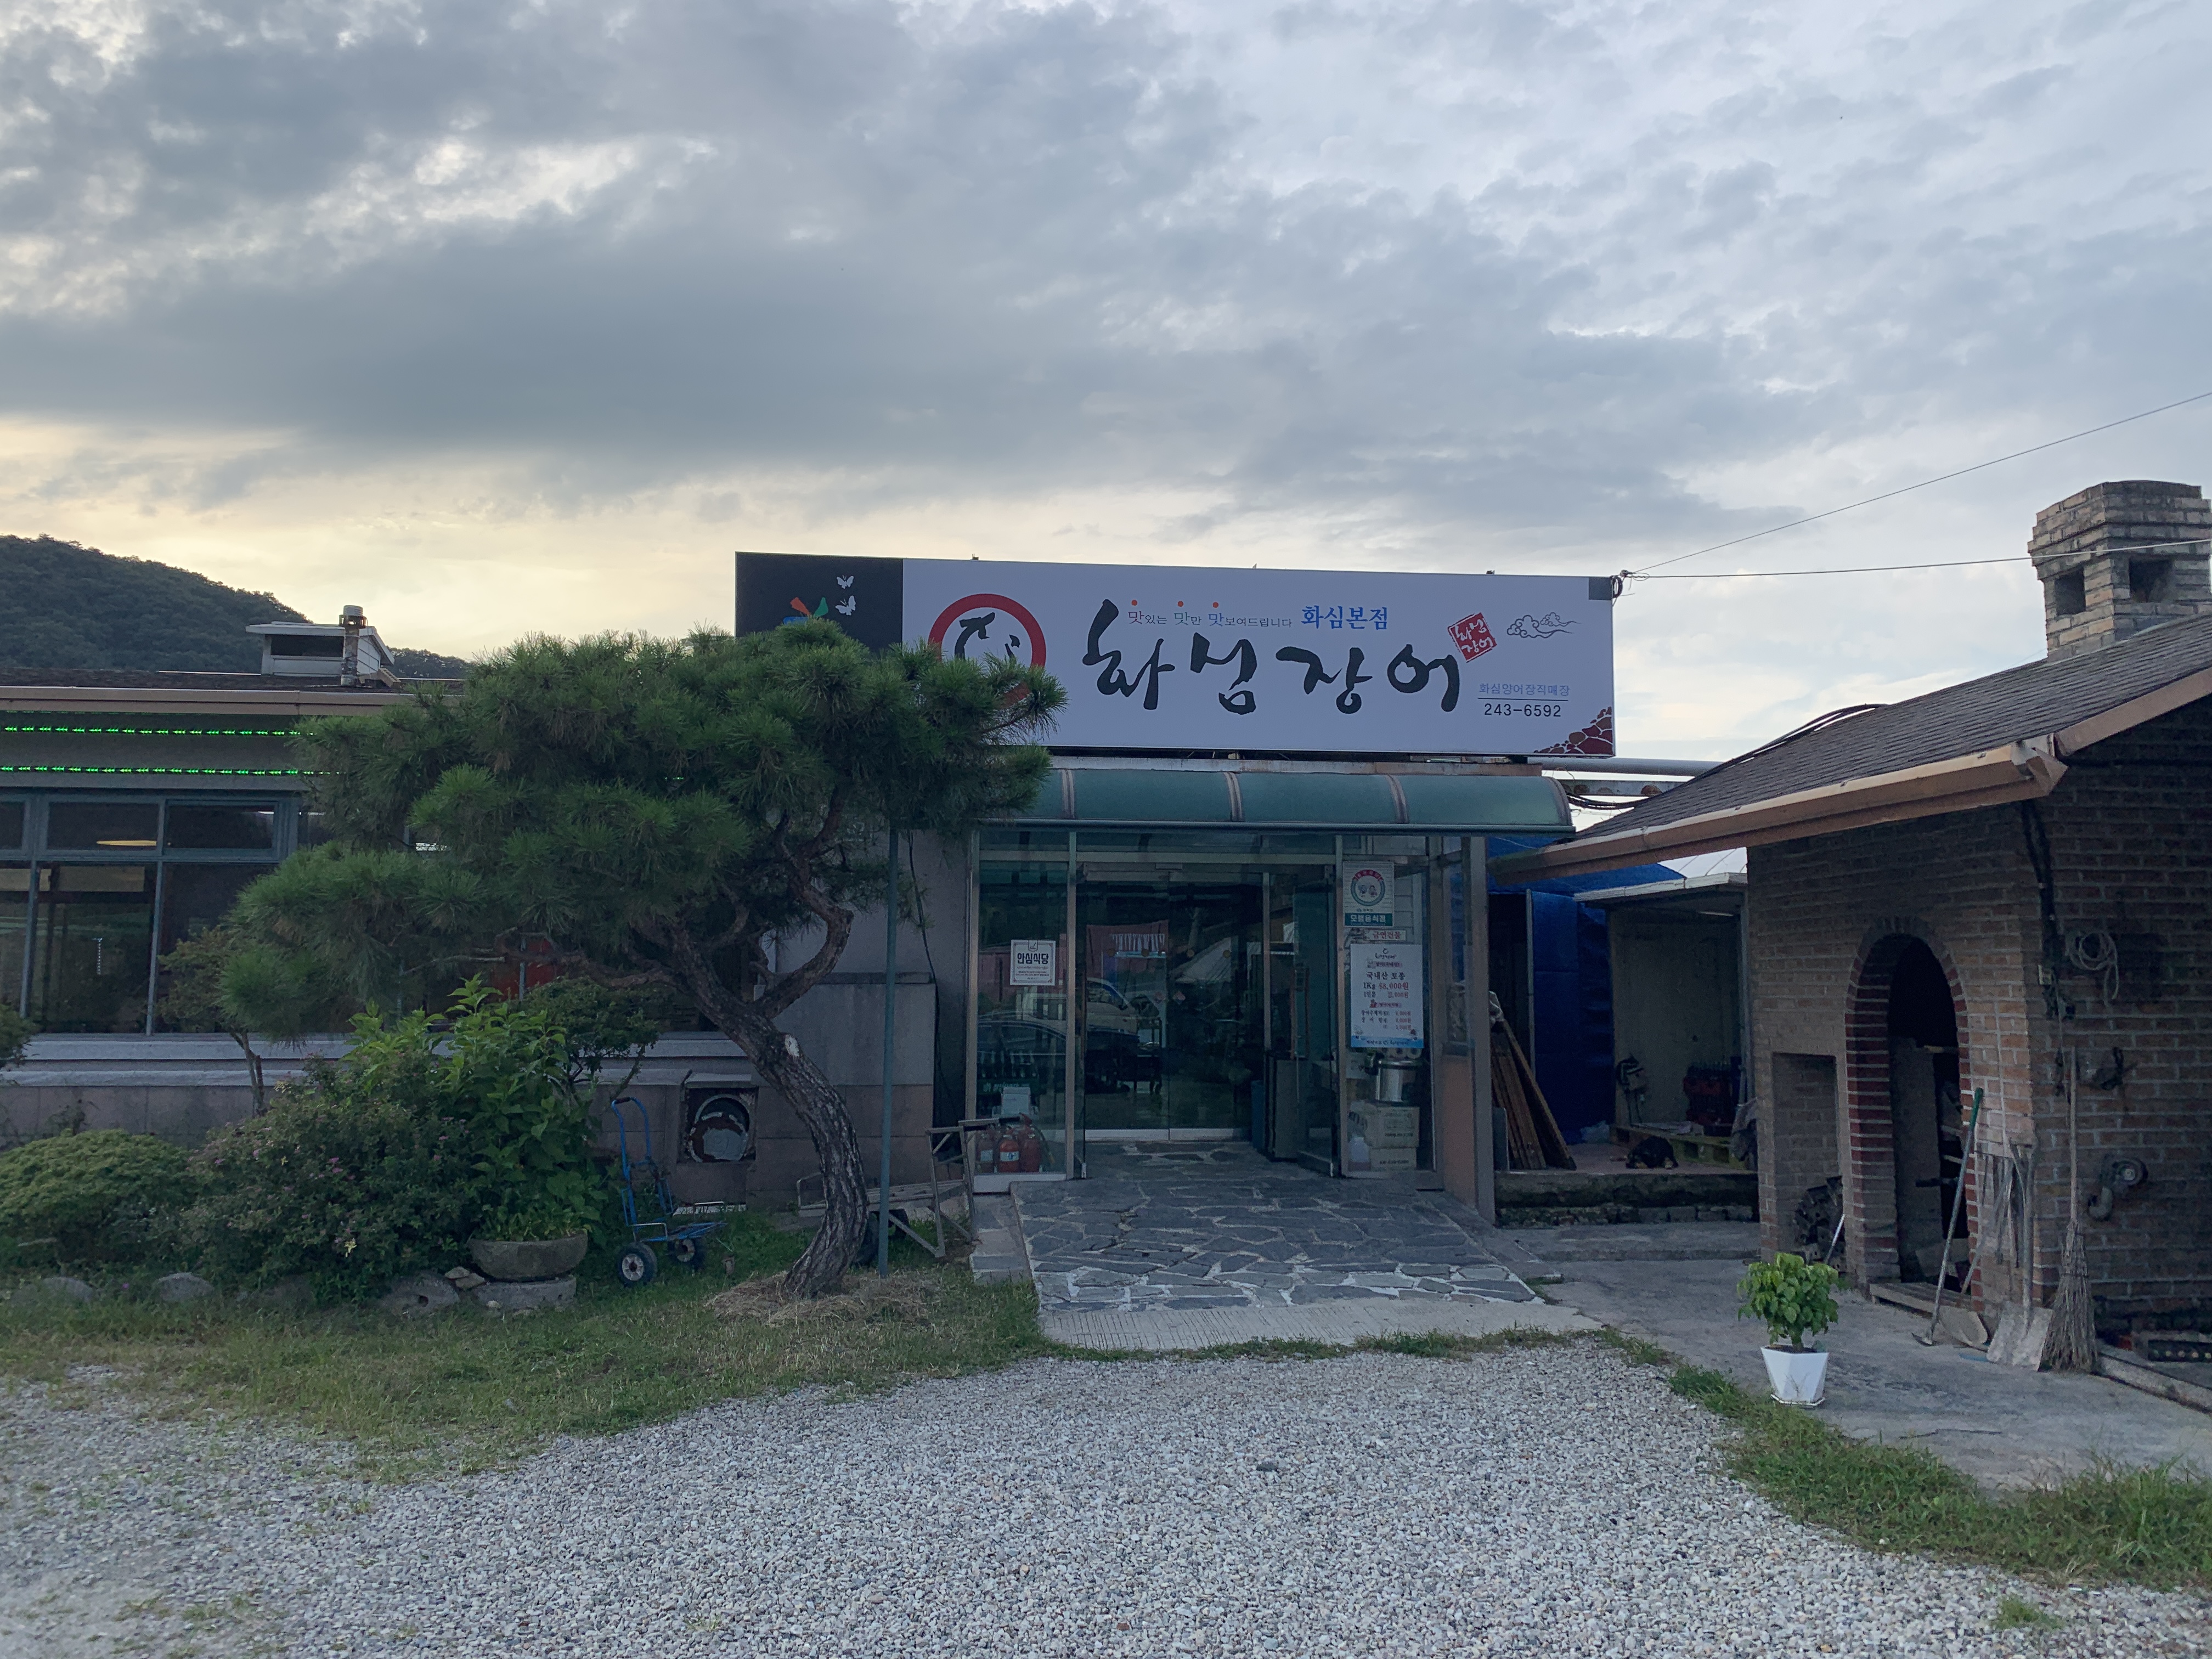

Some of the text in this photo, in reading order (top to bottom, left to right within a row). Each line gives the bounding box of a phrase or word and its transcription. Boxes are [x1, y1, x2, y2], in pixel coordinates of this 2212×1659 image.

[1127, 610, 1293, 628] 맛있는 맛만 맛보여드립니다
[1300, 604, 1388, 631] 화심본점
[1082, 599, 1460, 716] 화심장어
[1479, 682, 1570, 697] 화심양어장직매장
[1483, 702, 1562, 718] 243-6592
[1017, 952, 1049, 964] 안심식당
